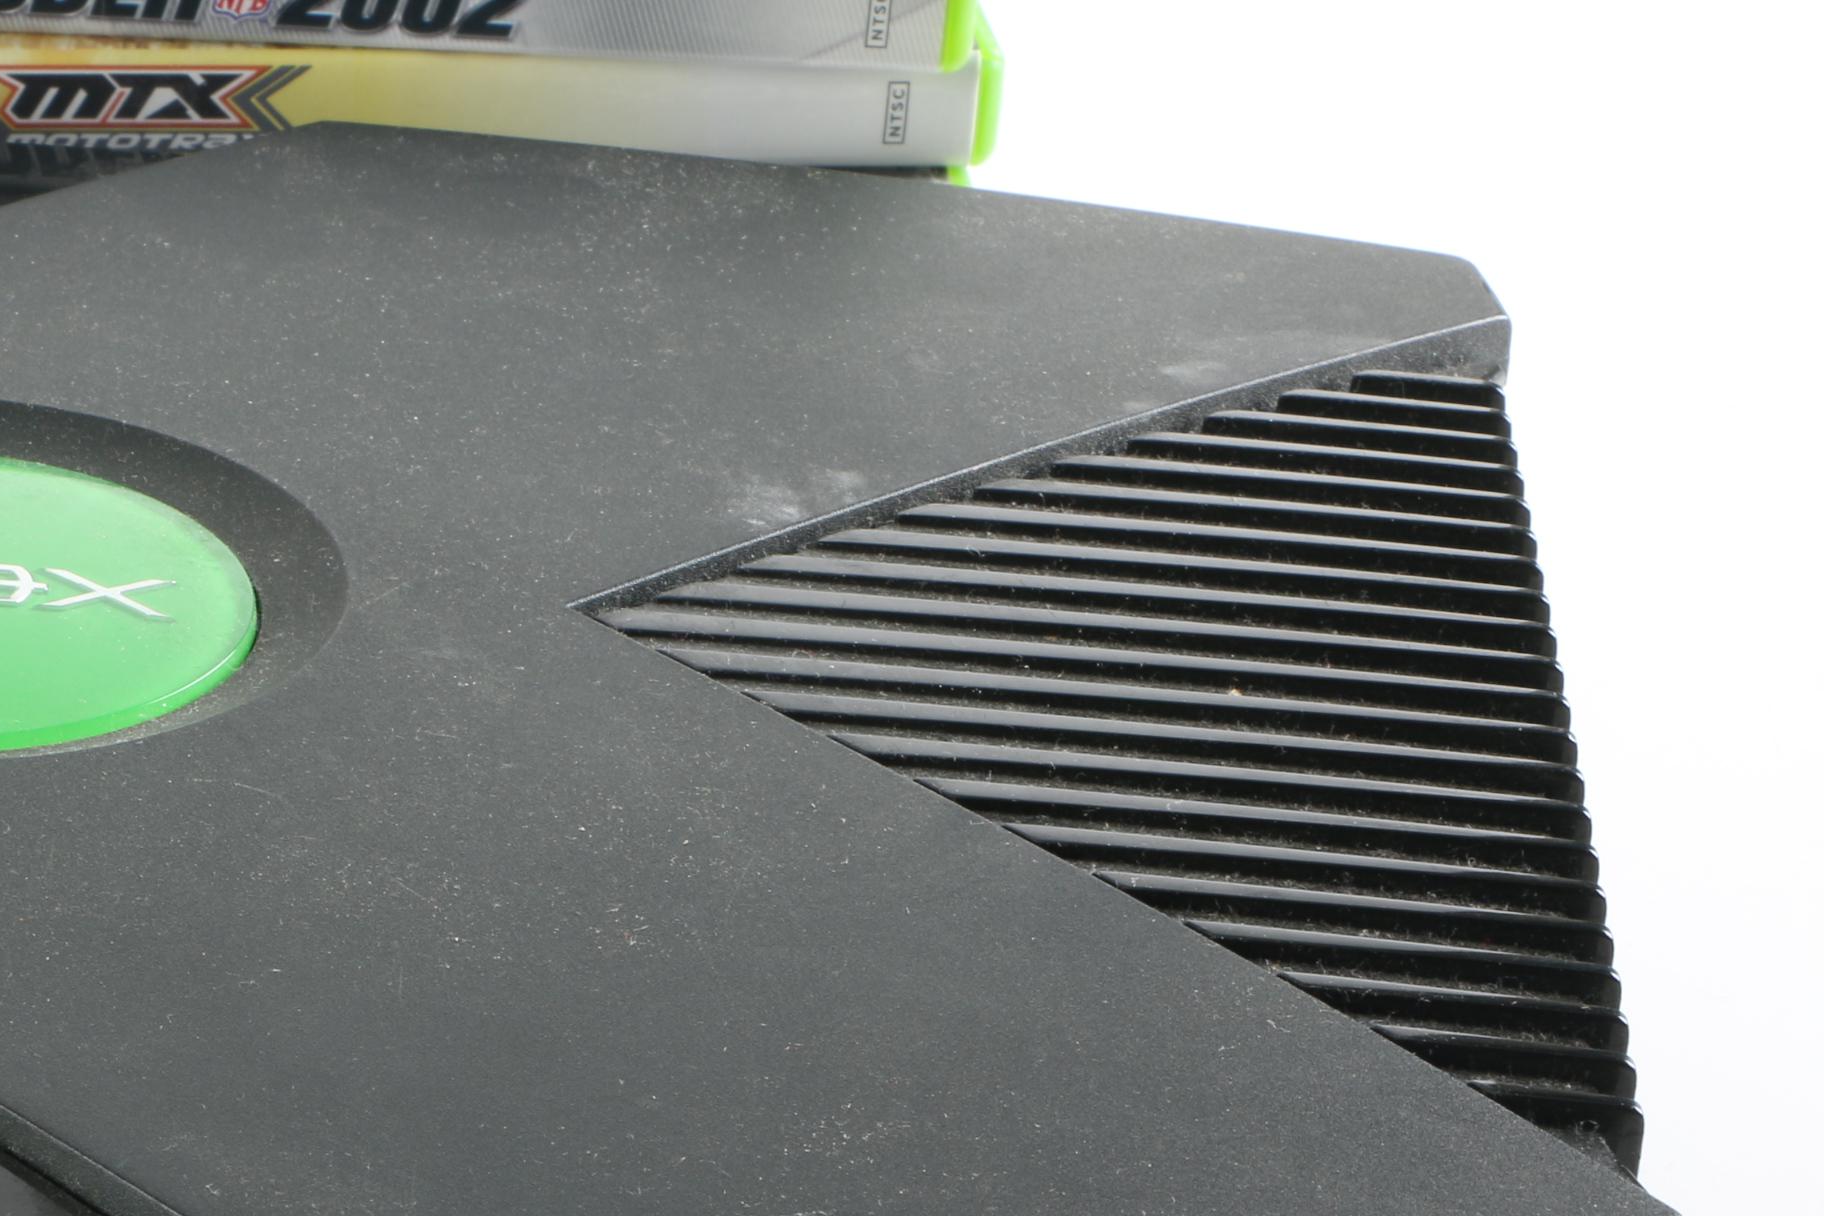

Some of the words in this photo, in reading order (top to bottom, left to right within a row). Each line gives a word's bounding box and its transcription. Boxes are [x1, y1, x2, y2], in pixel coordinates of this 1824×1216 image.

[871, 0, 887, 41] NTS
[2, 71, 240, 121] MTX
[888, 88, 906, 137] NTSC
[7, 132, 255, 149] MOTOTRA
